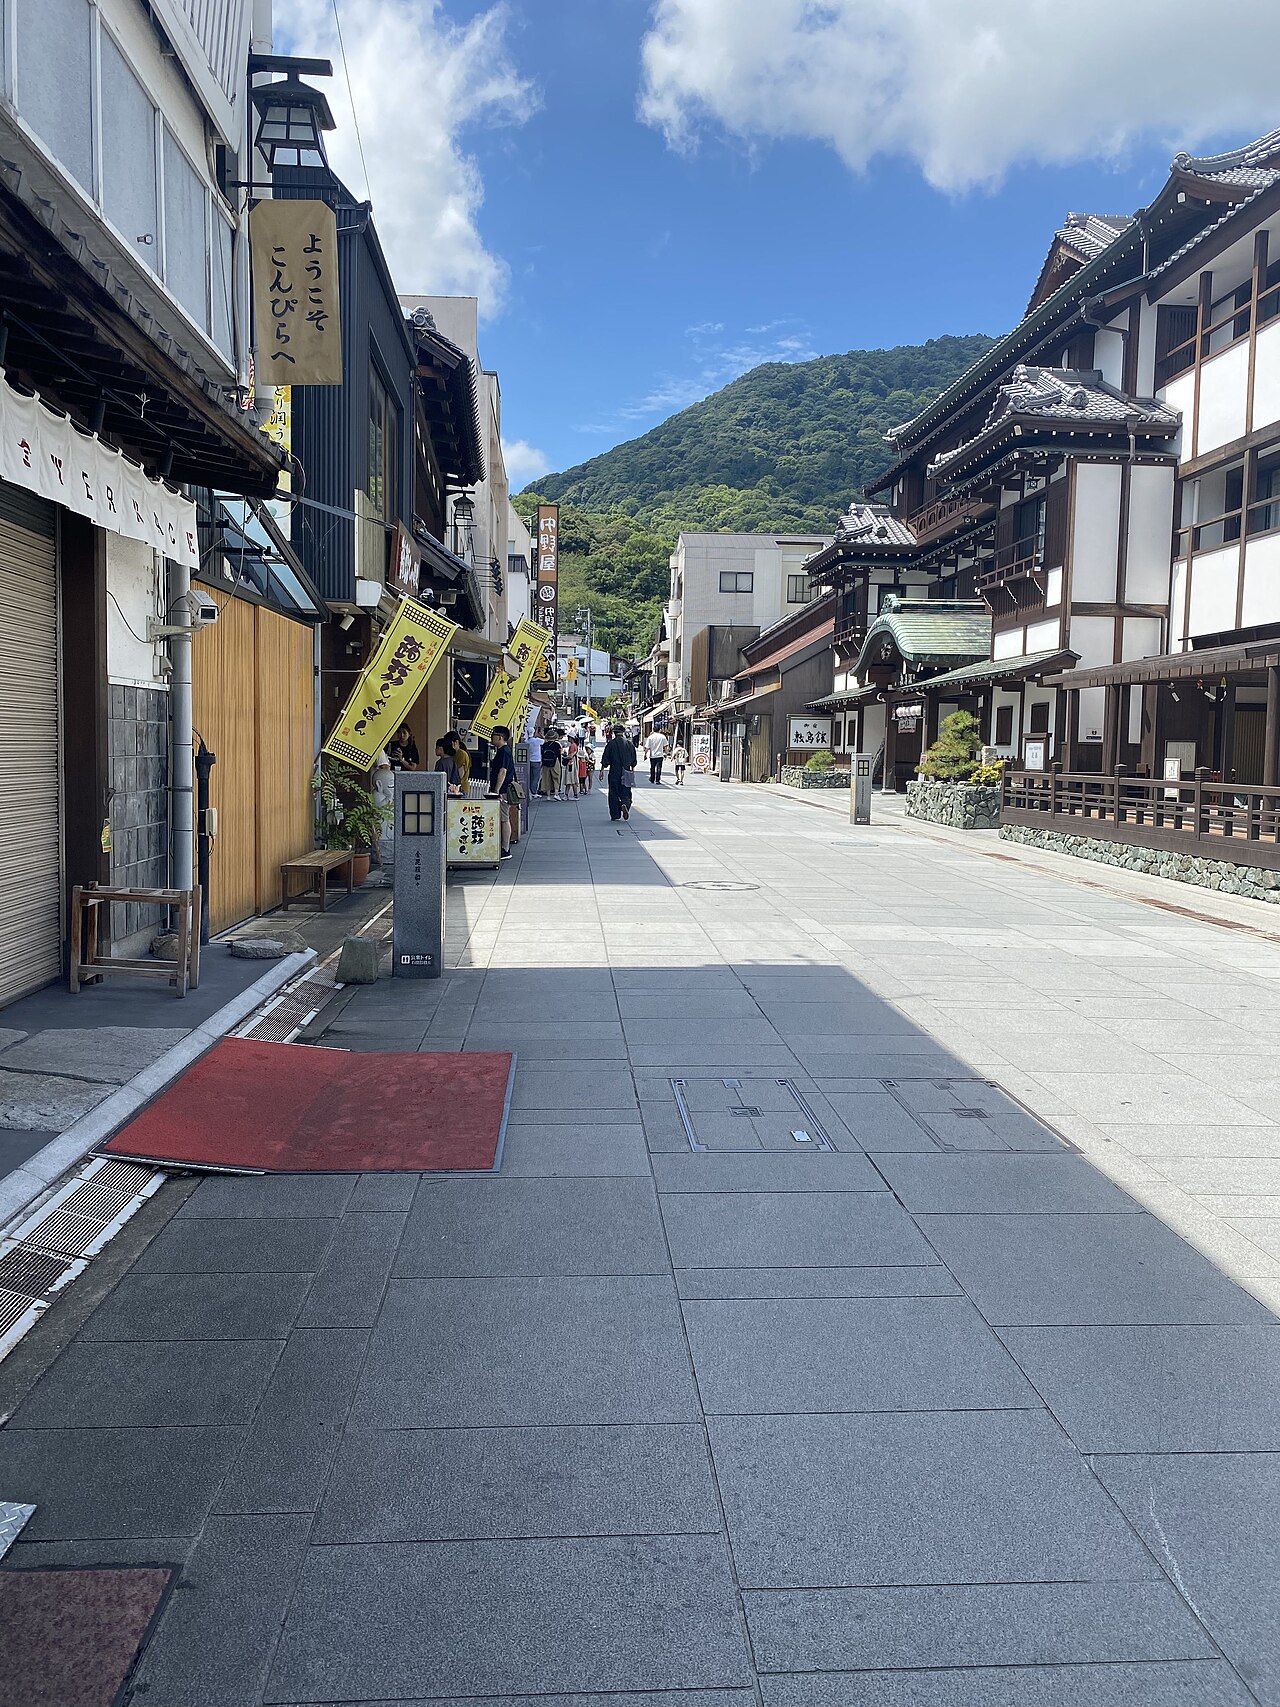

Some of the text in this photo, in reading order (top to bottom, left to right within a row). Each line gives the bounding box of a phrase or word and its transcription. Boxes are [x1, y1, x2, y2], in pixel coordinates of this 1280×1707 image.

[270, 245, 297, 365] こんぴらへ
[302, 233, 331, 333] ようこそ
[539, 516, 557, 571] 中野屋
[354, 634, 426, 737] 蒟蒻しゃぼん
